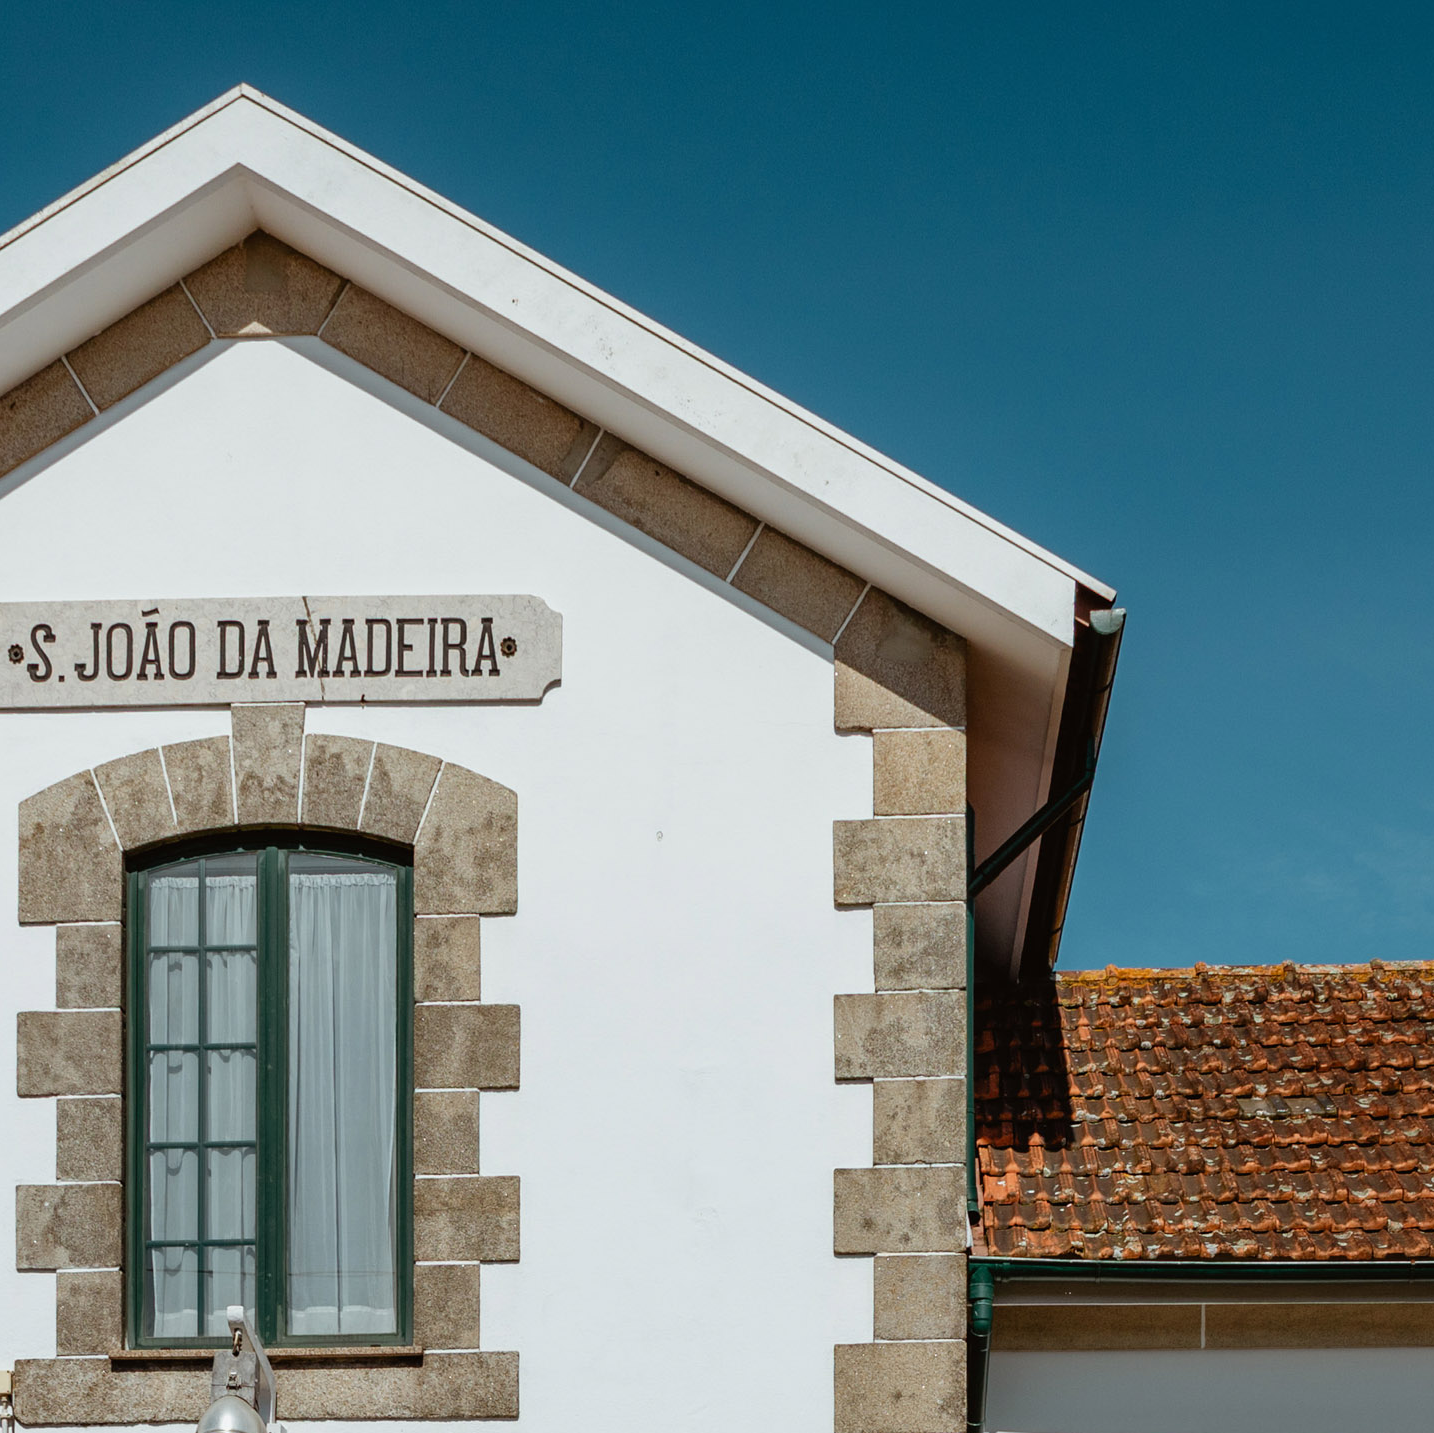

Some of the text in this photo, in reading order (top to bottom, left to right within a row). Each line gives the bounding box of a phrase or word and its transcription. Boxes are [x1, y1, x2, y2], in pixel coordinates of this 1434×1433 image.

[26, 608, 502, 683] S. JOÃO DA MADEIRA
